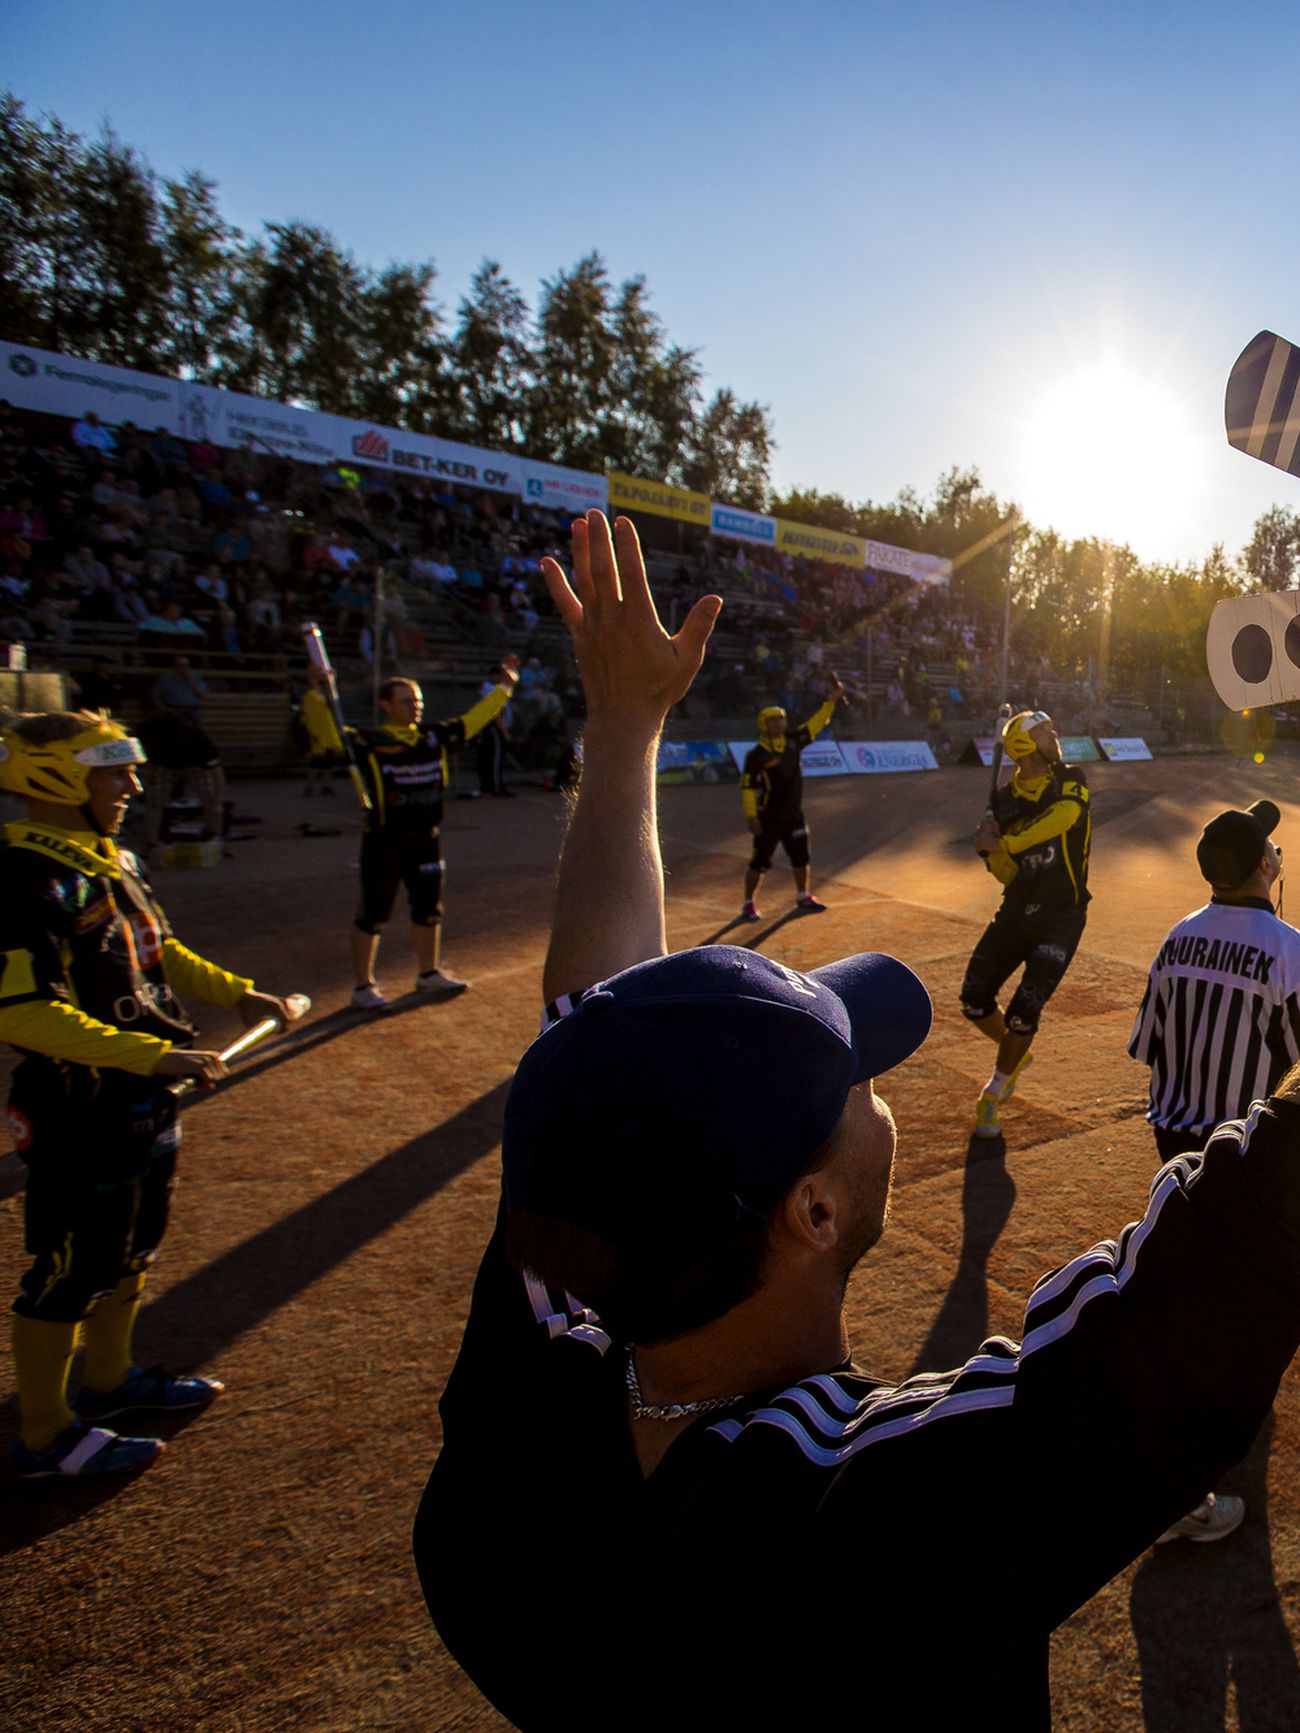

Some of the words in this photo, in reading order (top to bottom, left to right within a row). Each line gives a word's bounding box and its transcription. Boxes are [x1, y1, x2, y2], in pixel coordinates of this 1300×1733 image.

[392, 449, 477, 481] BET-KER
[484, 468, 509, 486] OY
[1070, 783, 1083, 797] 4
[23, 832, 95, 871] KALEVA
